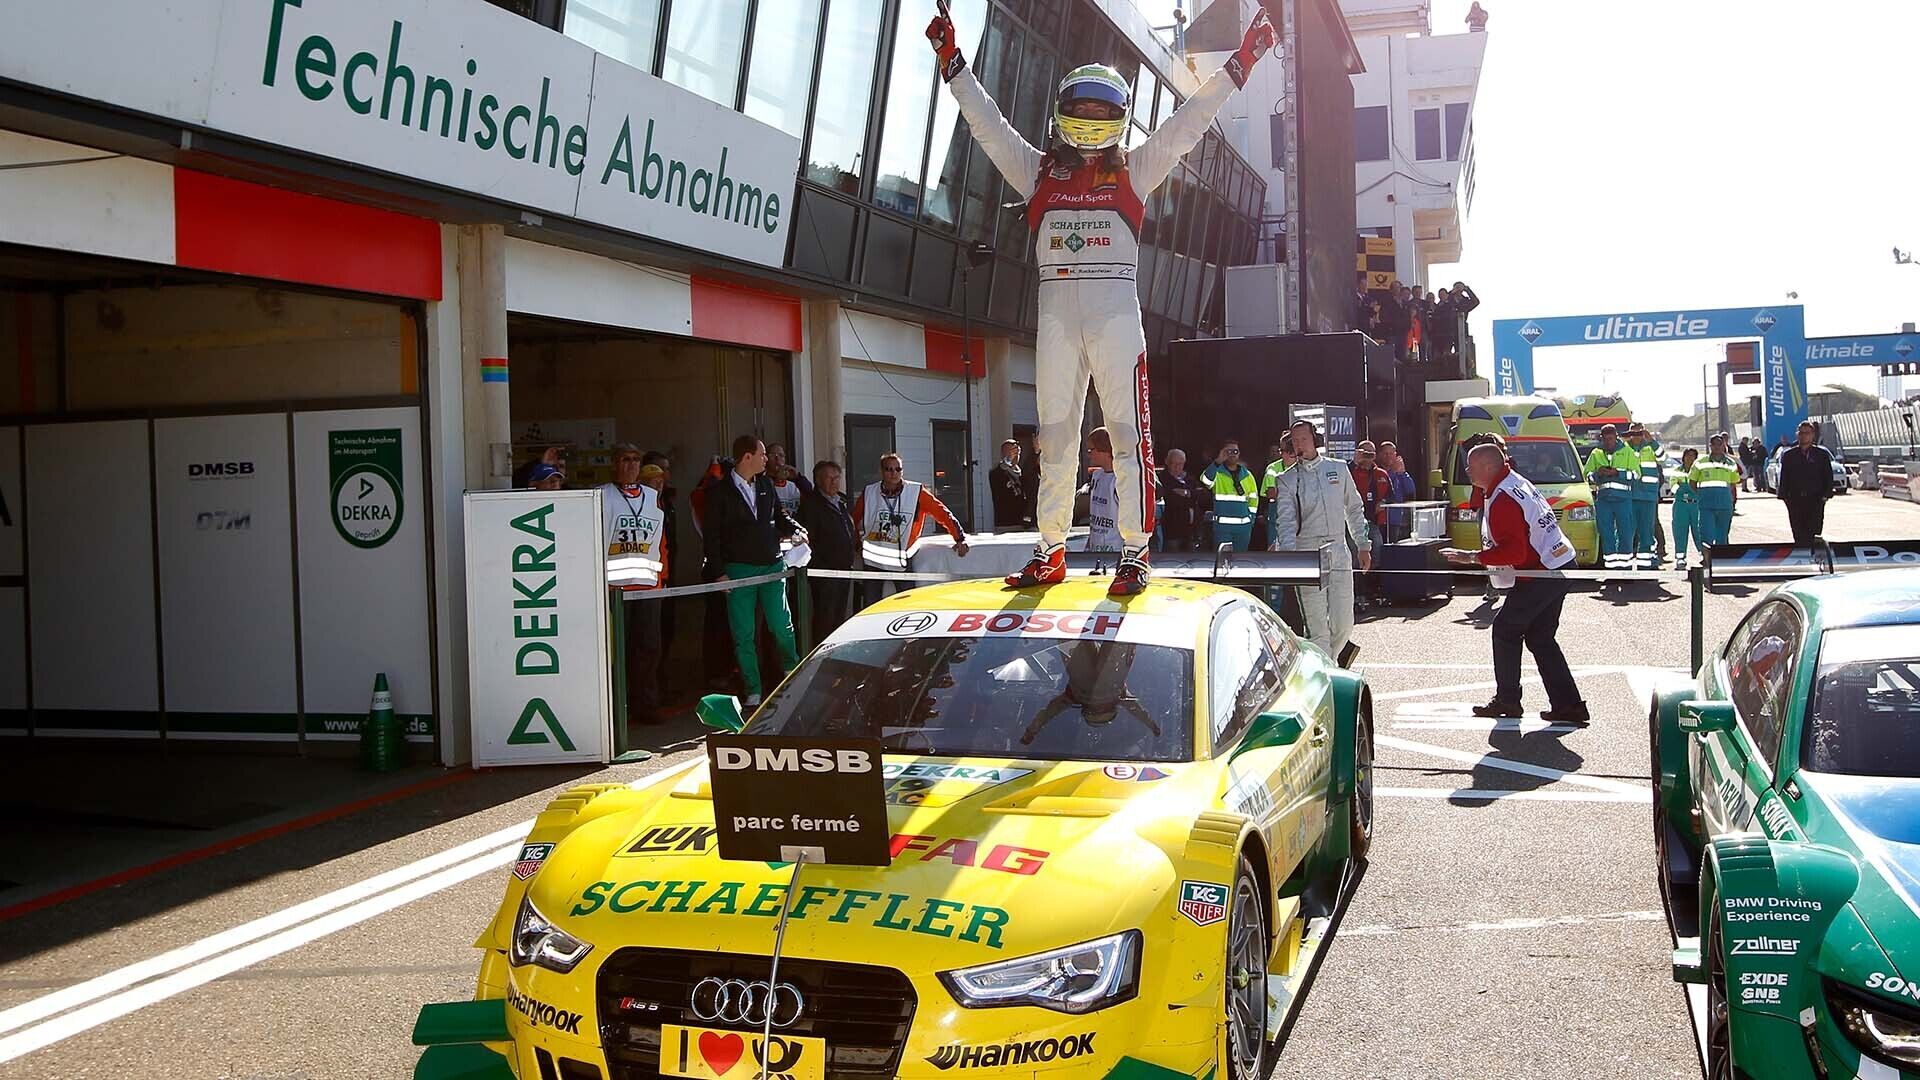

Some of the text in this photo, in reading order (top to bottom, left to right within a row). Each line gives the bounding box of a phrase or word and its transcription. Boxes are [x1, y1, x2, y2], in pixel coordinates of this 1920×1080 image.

[262, 0, 781, 234] Technische Abnahme
[1049, 220, 1111, 231] SCHAEFFLER
[1086, 237, 1110, 247] FAG
[1583, 313, 1709, 341] ultimate
[1753, 316, 1776, 325] ARAL
[1519, 327, 1541, 336] ARAL
[1806, 341, 1874, 360] ltimate
[1765, 345, 1785, 417] ultimate
[1330, 416, 1353, 436] DTM
[188, 461, 255, 476] DMSB
[342, 505, 392, 521] DEKRA
[619, 541, 645, 554] ADAC
[509, 502, 560, 676] DEKRA
[946, 613, 1126, 636] BOSCH
[716, 747, 873, 774] DMSB
[733, 814, 861, 832] parc fermé
[1760, 798, 1794, 841] SONAX
[524, 846, 545, 861] TAG
[891, 834, 1051, 876] FAG
[515, 860, 542, 878] HEUER
[1190, 884, 1220, 904] TAG
[1182, 901, 1223, 926] HEUER
[1725, 897, 1822, 912] BMW Driving
[570, 880, 1010, 950] SCHAEFFLER
[1726, 911, 1811, 924] Experience
[1739, 972, 1789, 987] EXIDE
[1741, 987, 1780, 999] GNB
